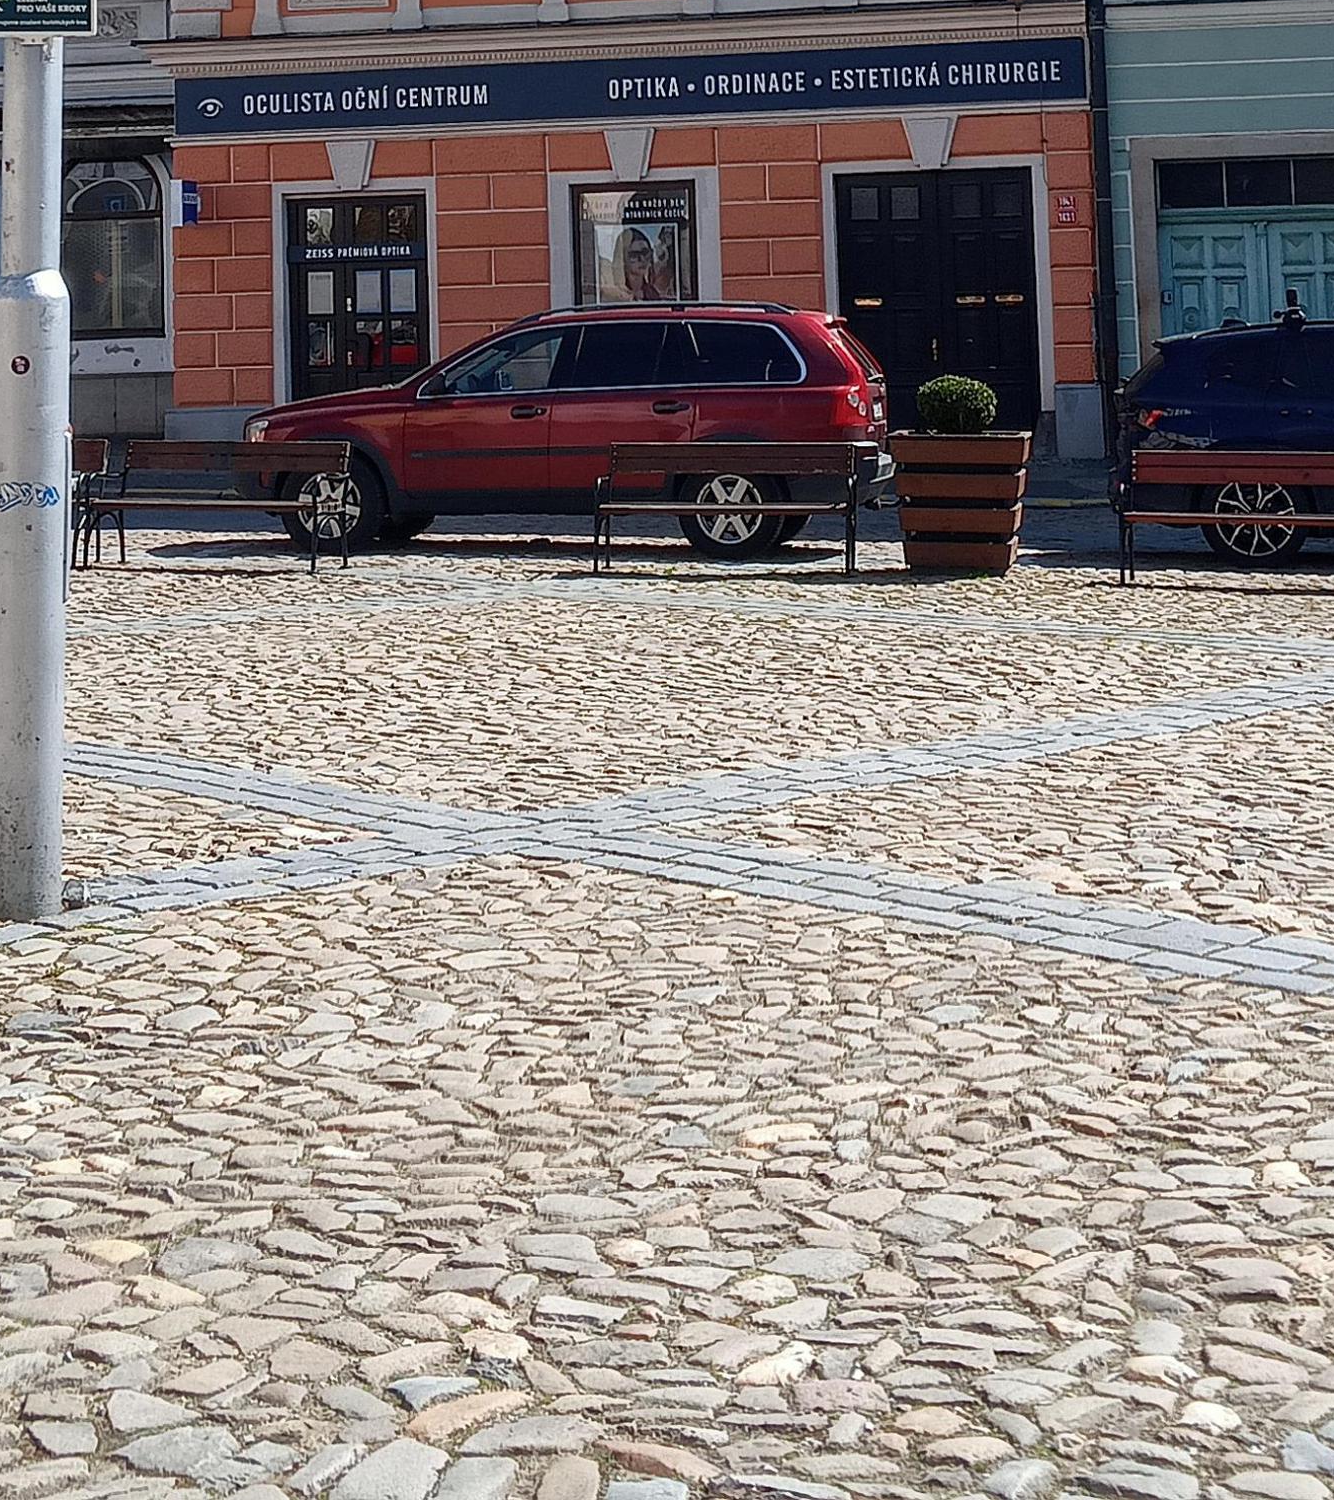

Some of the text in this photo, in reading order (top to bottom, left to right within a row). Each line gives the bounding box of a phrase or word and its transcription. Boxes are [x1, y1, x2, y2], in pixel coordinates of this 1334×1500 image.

[16, 2, 87, 13] PRO VAŠE KROKY
[608, 60, 1062, 100] OPTIKA ORDINACE ESTETICKÁ CHIRURGIE
[243, 84, 489, 115] OCULISTA OČNÍ CENTRUM
[305, 248, 334, 259] ZEISS
[381, 245, 411, 257] OPTIKA
